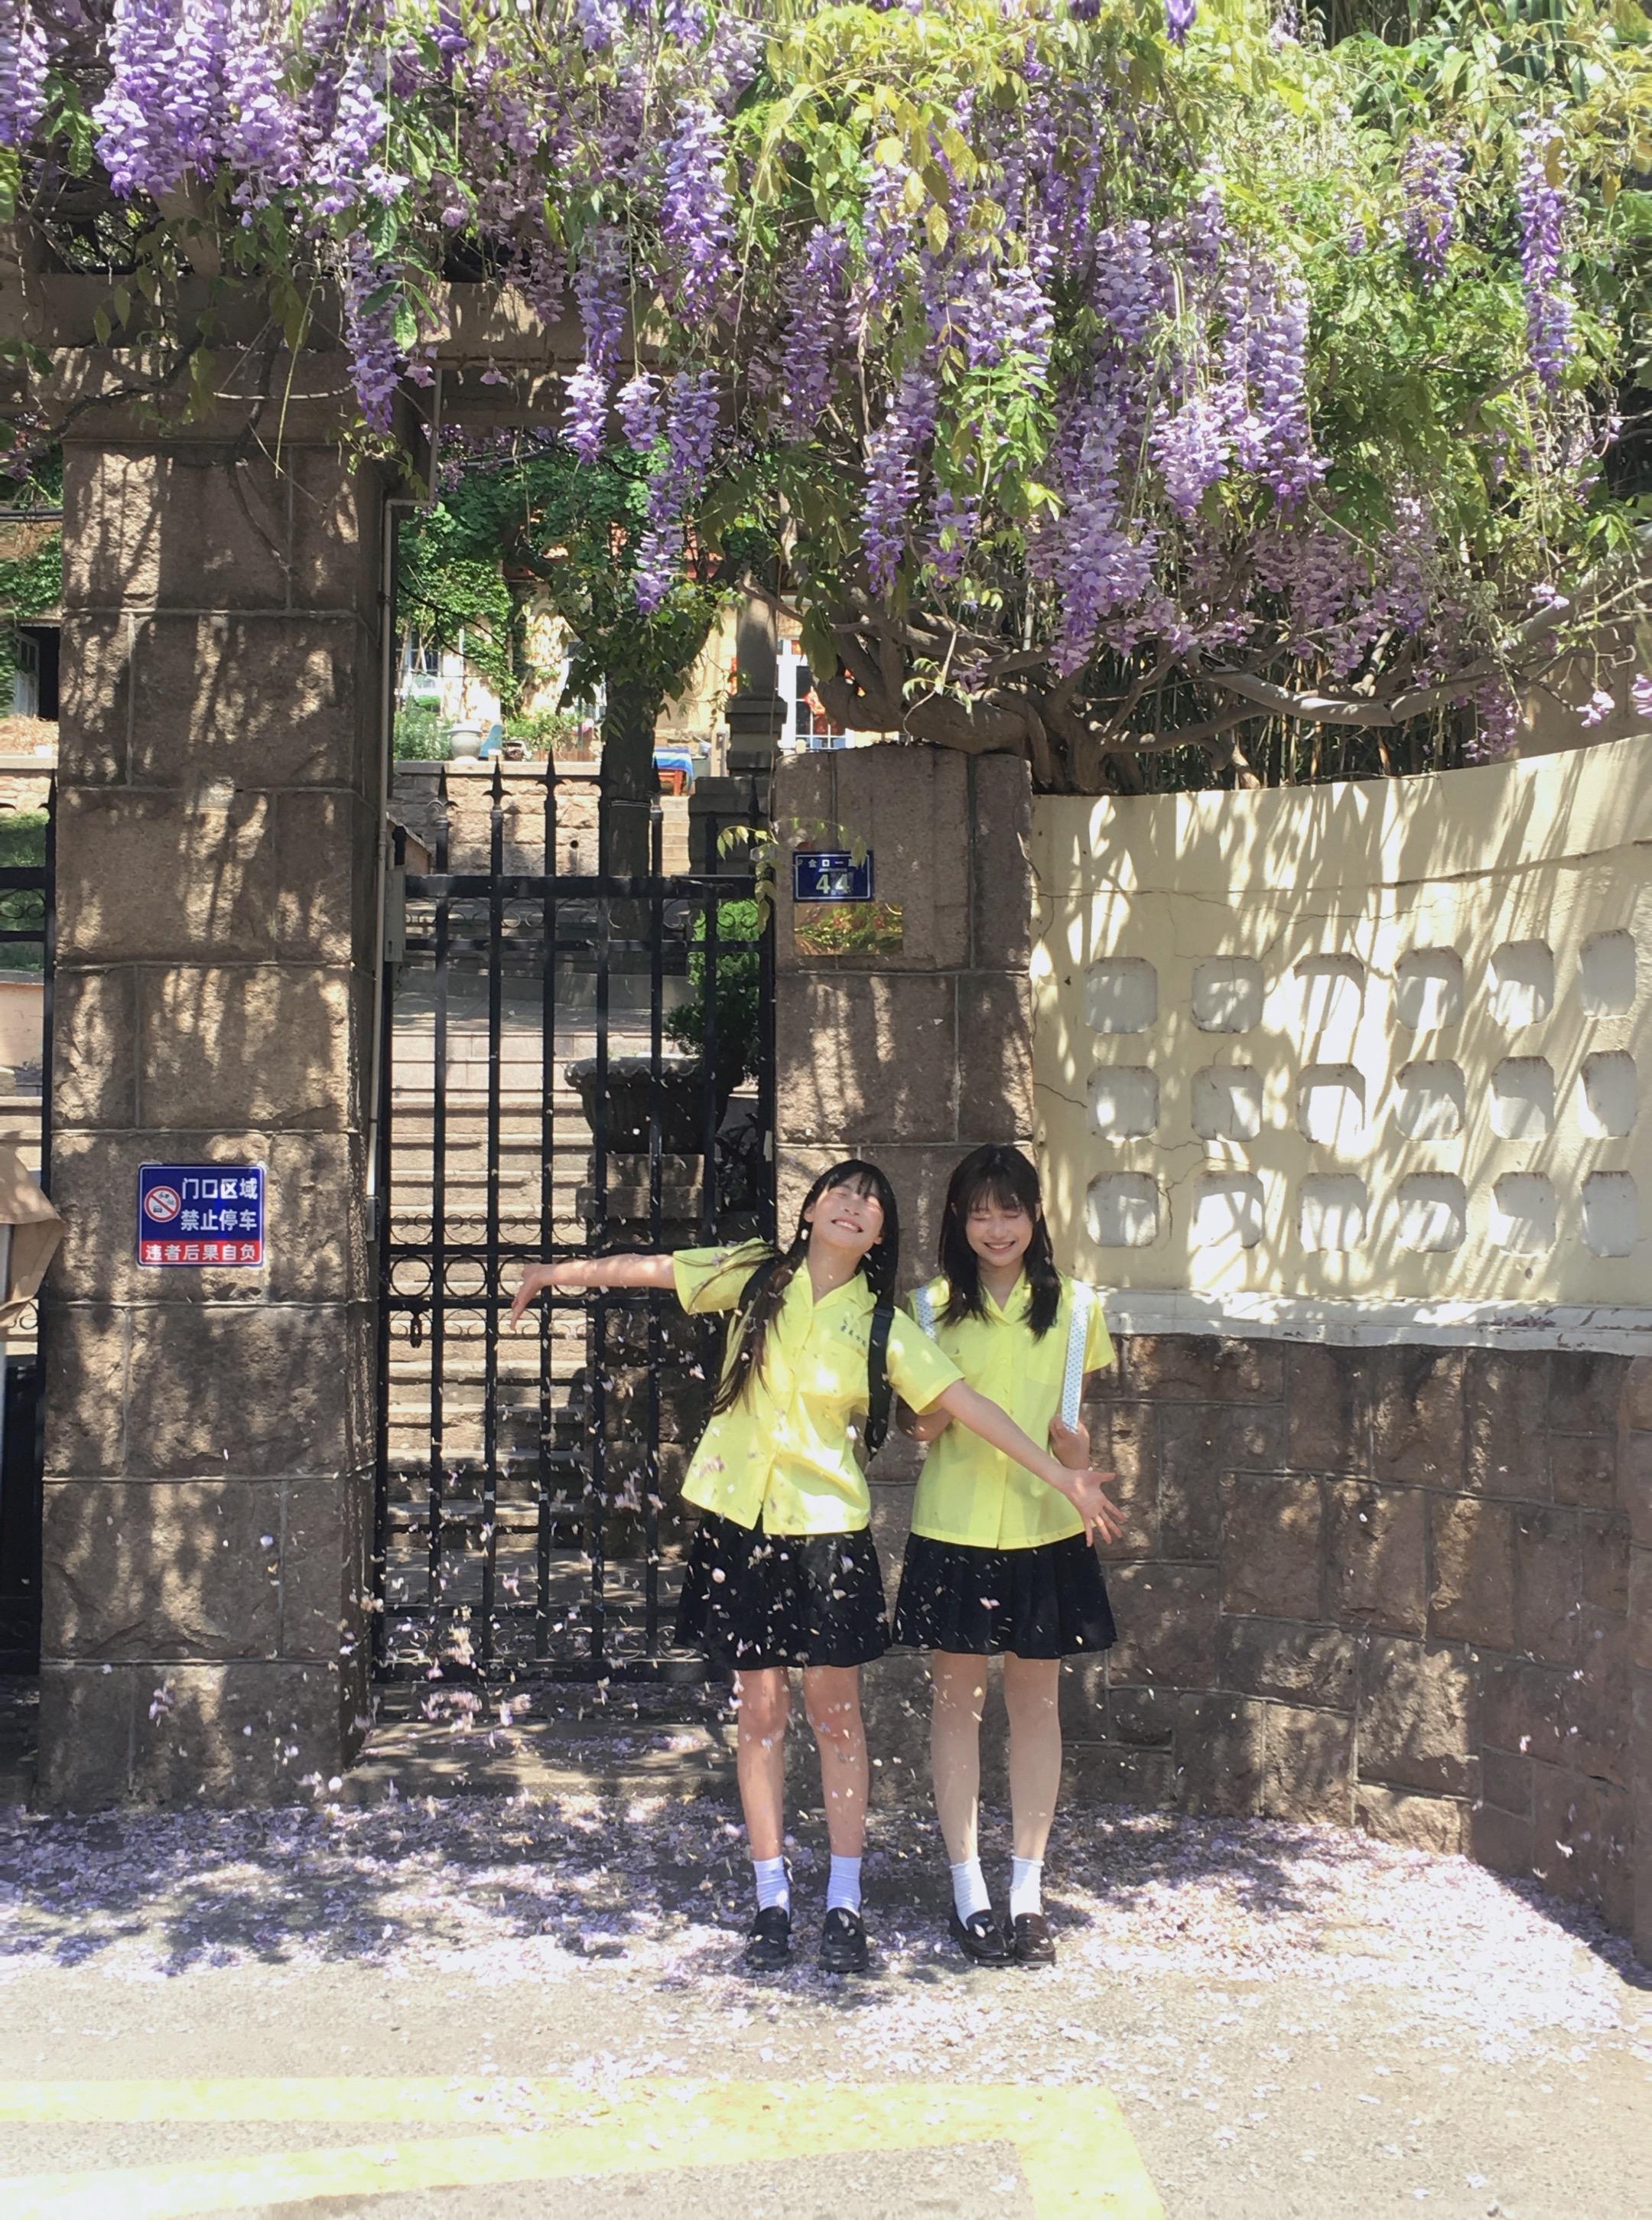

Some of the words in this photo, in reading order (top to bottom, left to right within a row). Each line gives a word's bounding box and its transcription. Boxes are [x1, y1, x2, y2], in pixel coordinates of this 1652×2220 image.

[815, 874, 850, 894] 44
[182, 1177, 259, 1200] 门口区域
[180, 1209, 258, 1232] 禁止停车
[145, 1244, 255, 1261] 违者后果自负
